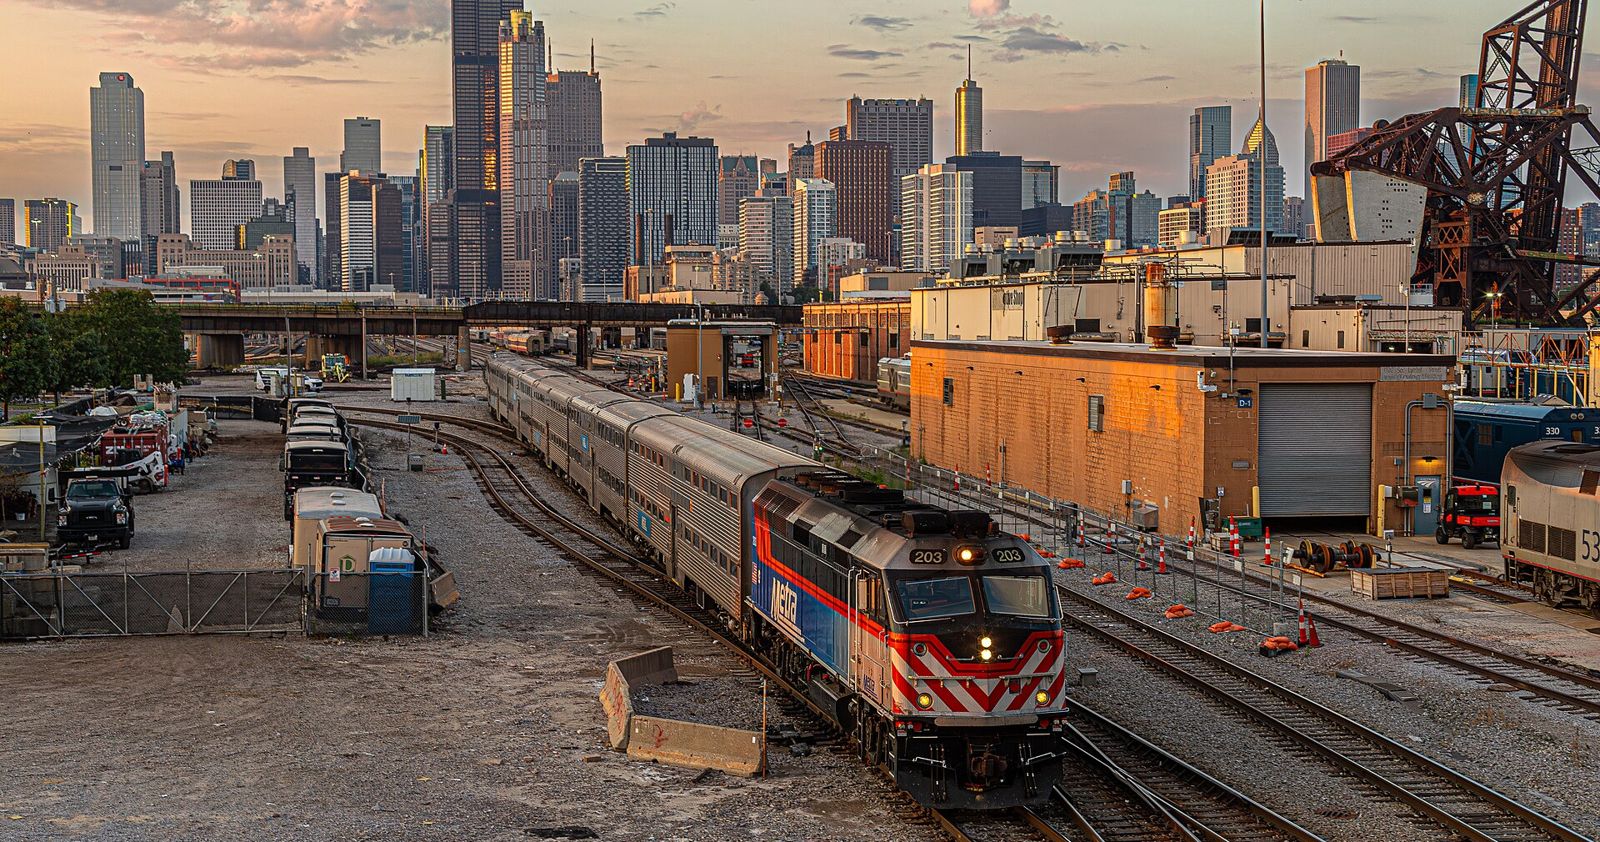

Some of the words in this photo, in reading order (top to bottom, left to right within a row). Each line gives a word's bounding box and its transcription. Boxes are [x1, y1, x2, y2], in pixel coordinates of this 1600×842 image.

[1545, 427, 1560, 435] 330
[914, 551, 942, 563] 203
[996, 550, 1021, 562] 203
[770, 577, 797, 624] Metra
